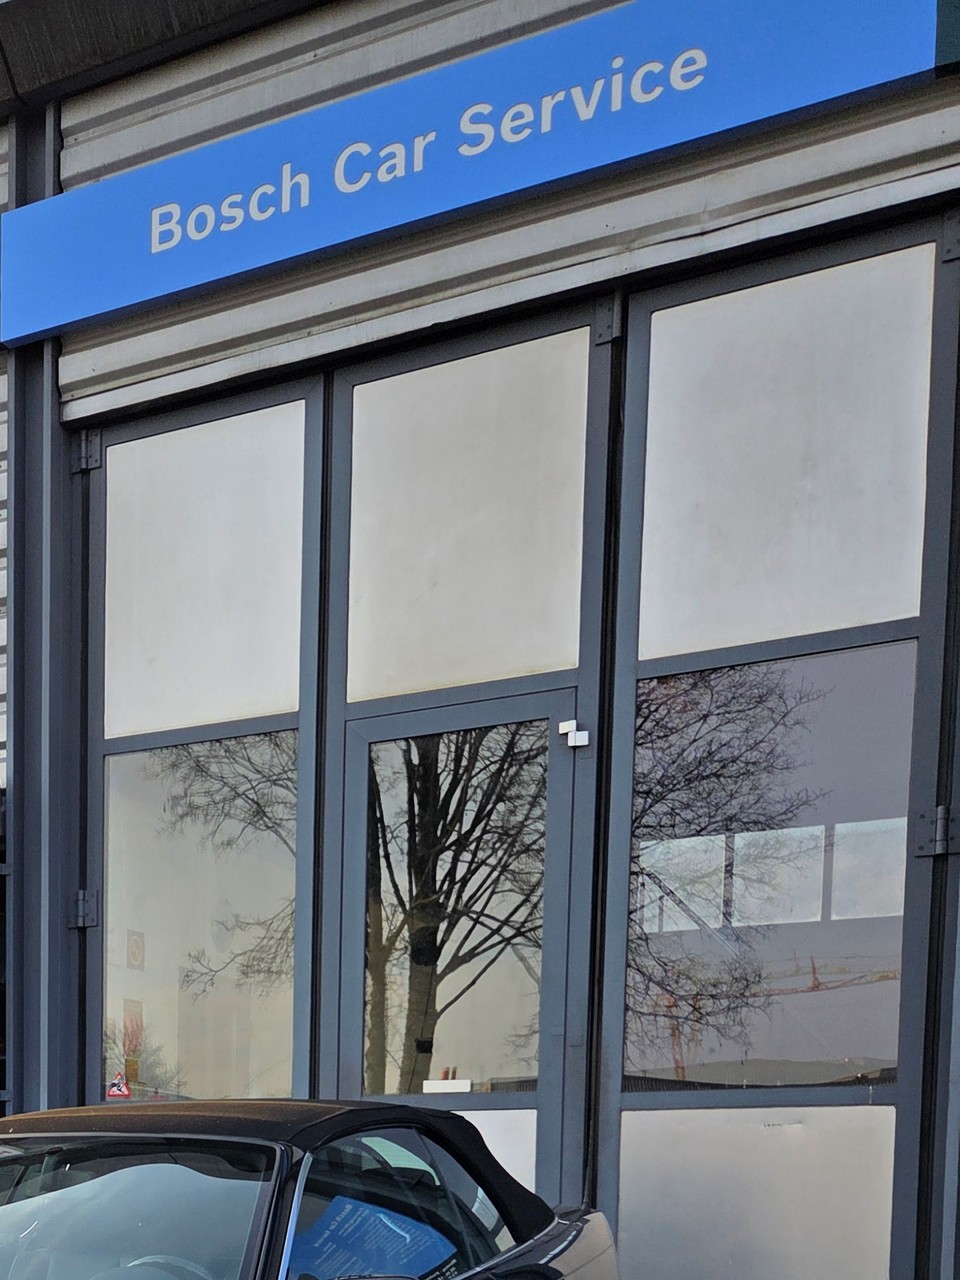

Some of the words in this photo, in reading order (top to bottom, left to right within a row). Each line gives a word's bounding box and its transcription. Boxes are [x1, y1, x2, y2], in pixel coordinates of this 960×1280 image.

[149, 161, 310, 254] Bosch
[333, 130, 437, 193] Car
[456, 47, 708, 157] Service
